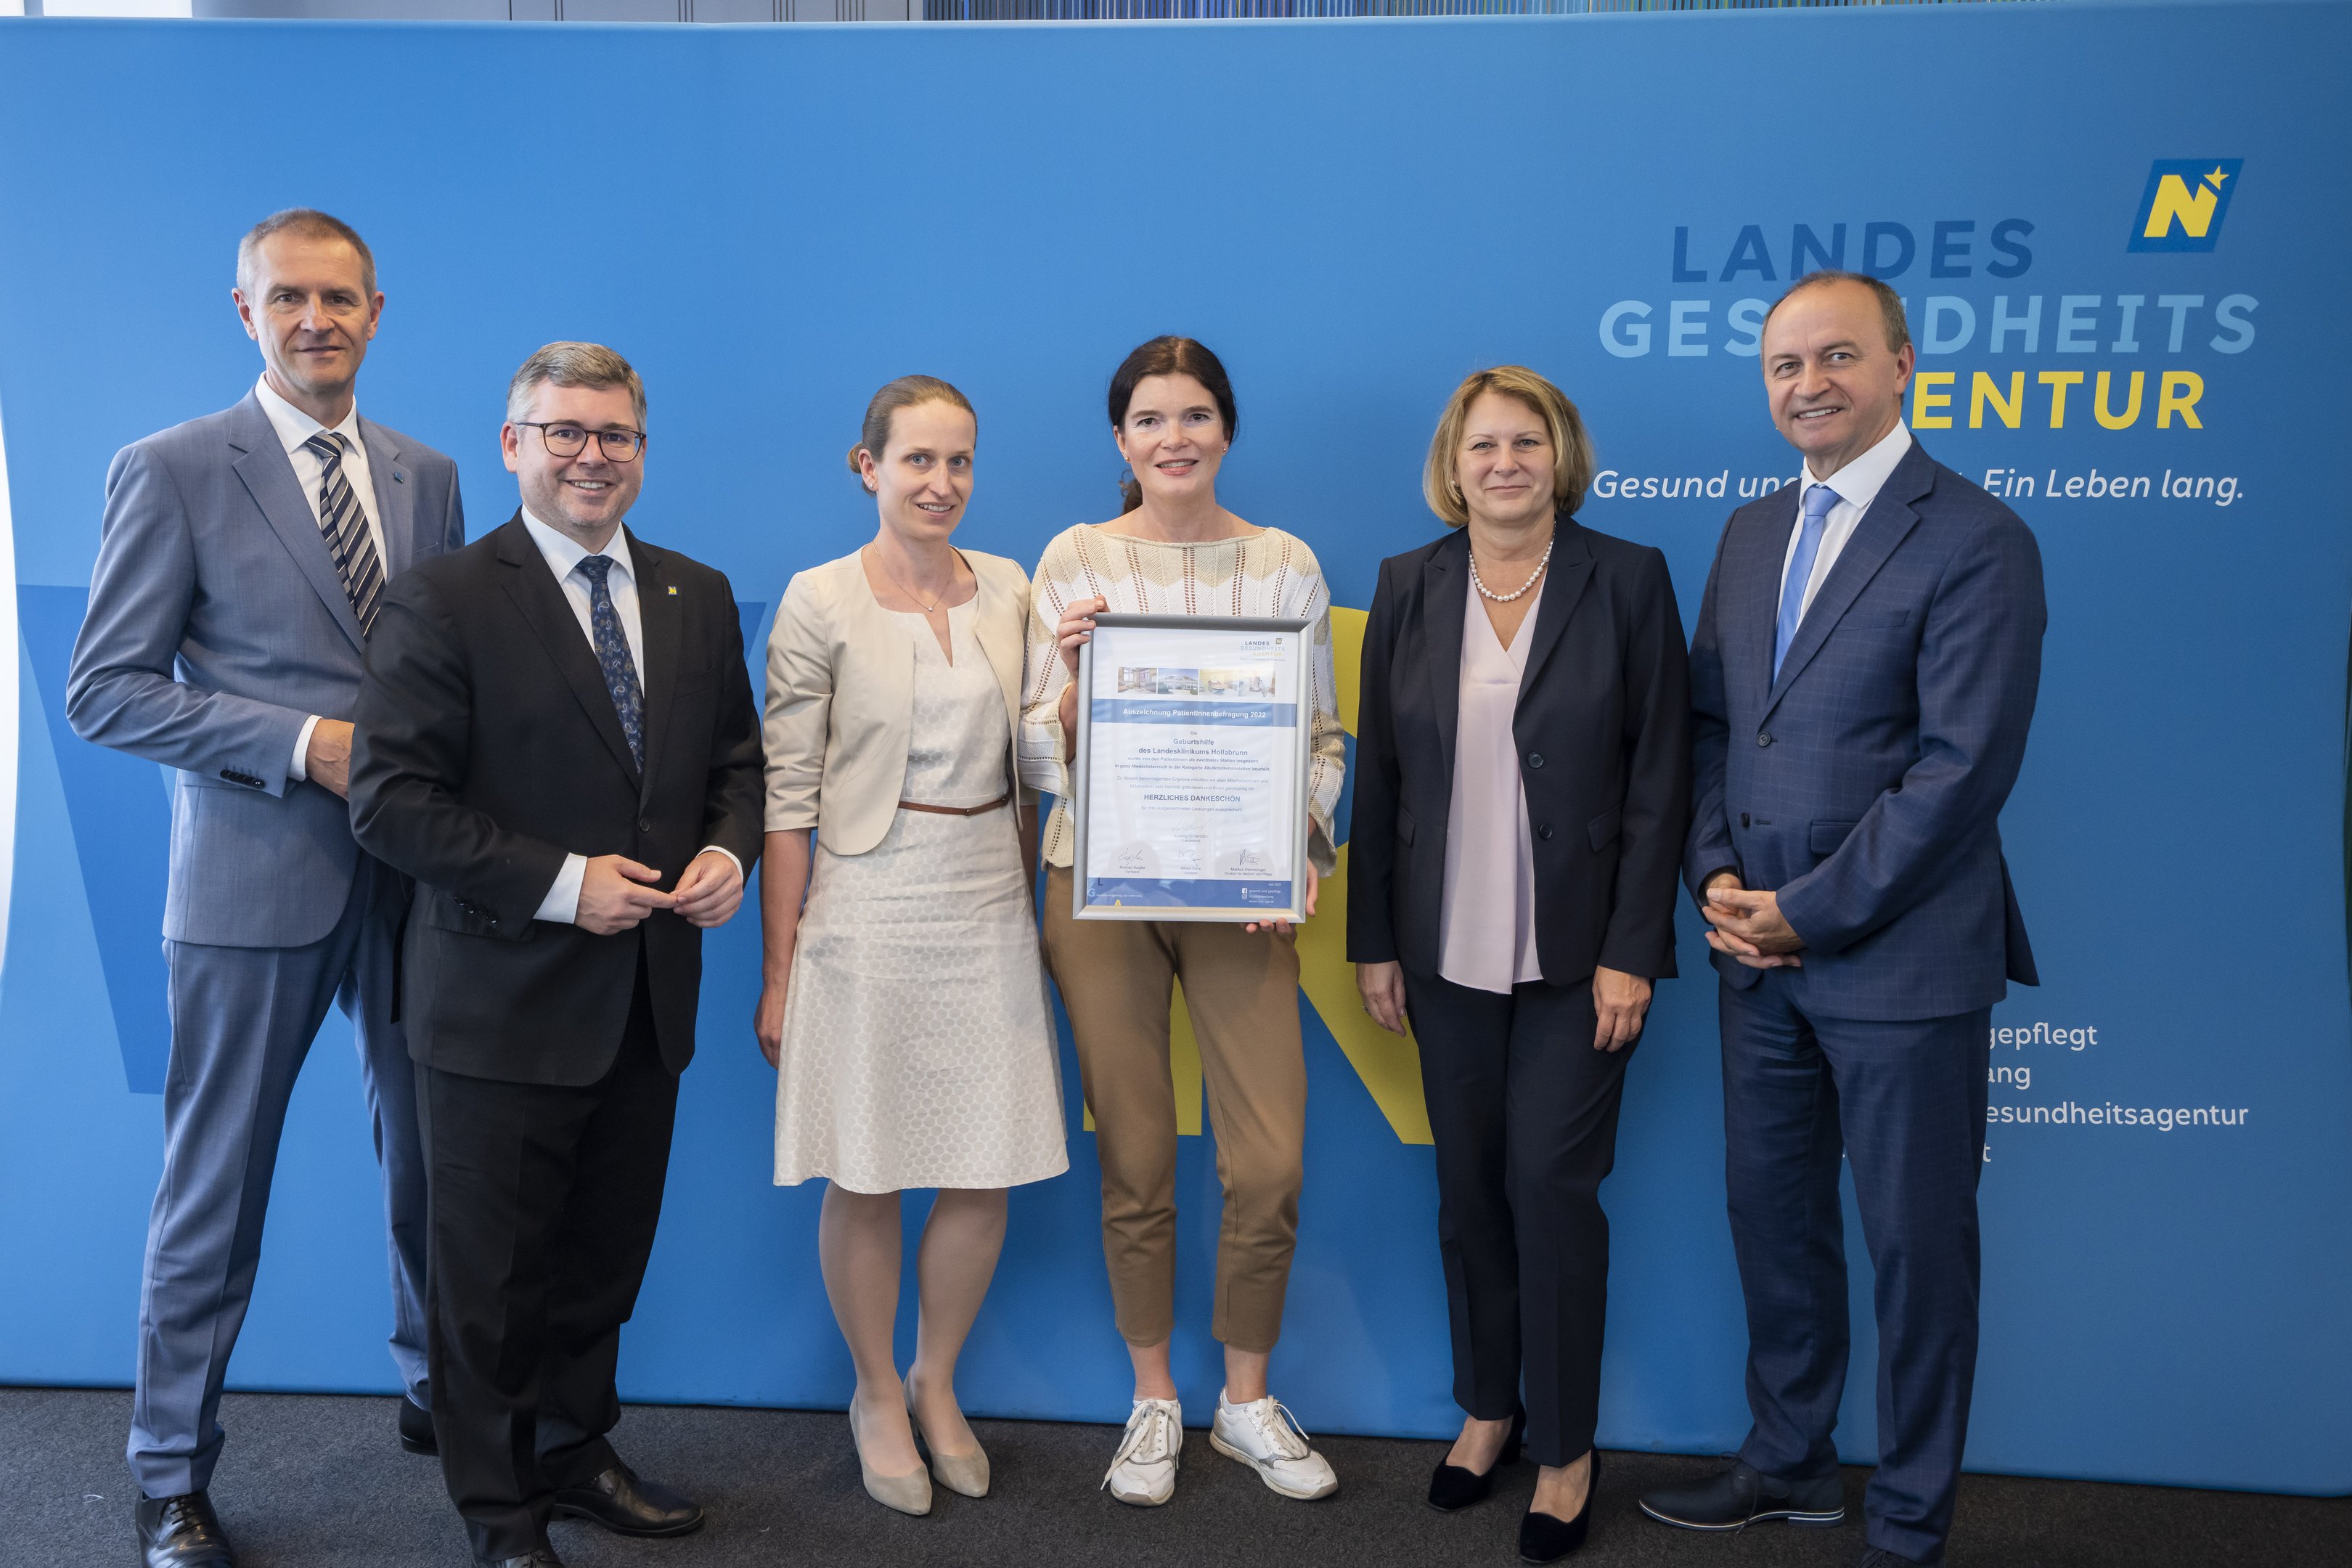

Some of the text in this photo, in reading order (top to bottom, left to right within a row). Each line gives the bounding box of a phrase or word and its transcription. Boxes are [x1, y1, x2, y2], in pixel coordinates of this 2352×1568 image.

[1672, 219, 2035, 283] LANDES
[1598, 294, 2260, 359] GESDHEITS
[1911, 371, 2205, 430] ENTUR
[1593, 467, 2244, 507] Gesund un Ein Leben lang.
[1122, 709, 1171, 717] Auszeichnung
[1172, 709, 1249, 719] PatientInnenbefragung
[1985, 1101, 2249, 1132] esundheitsagentur
